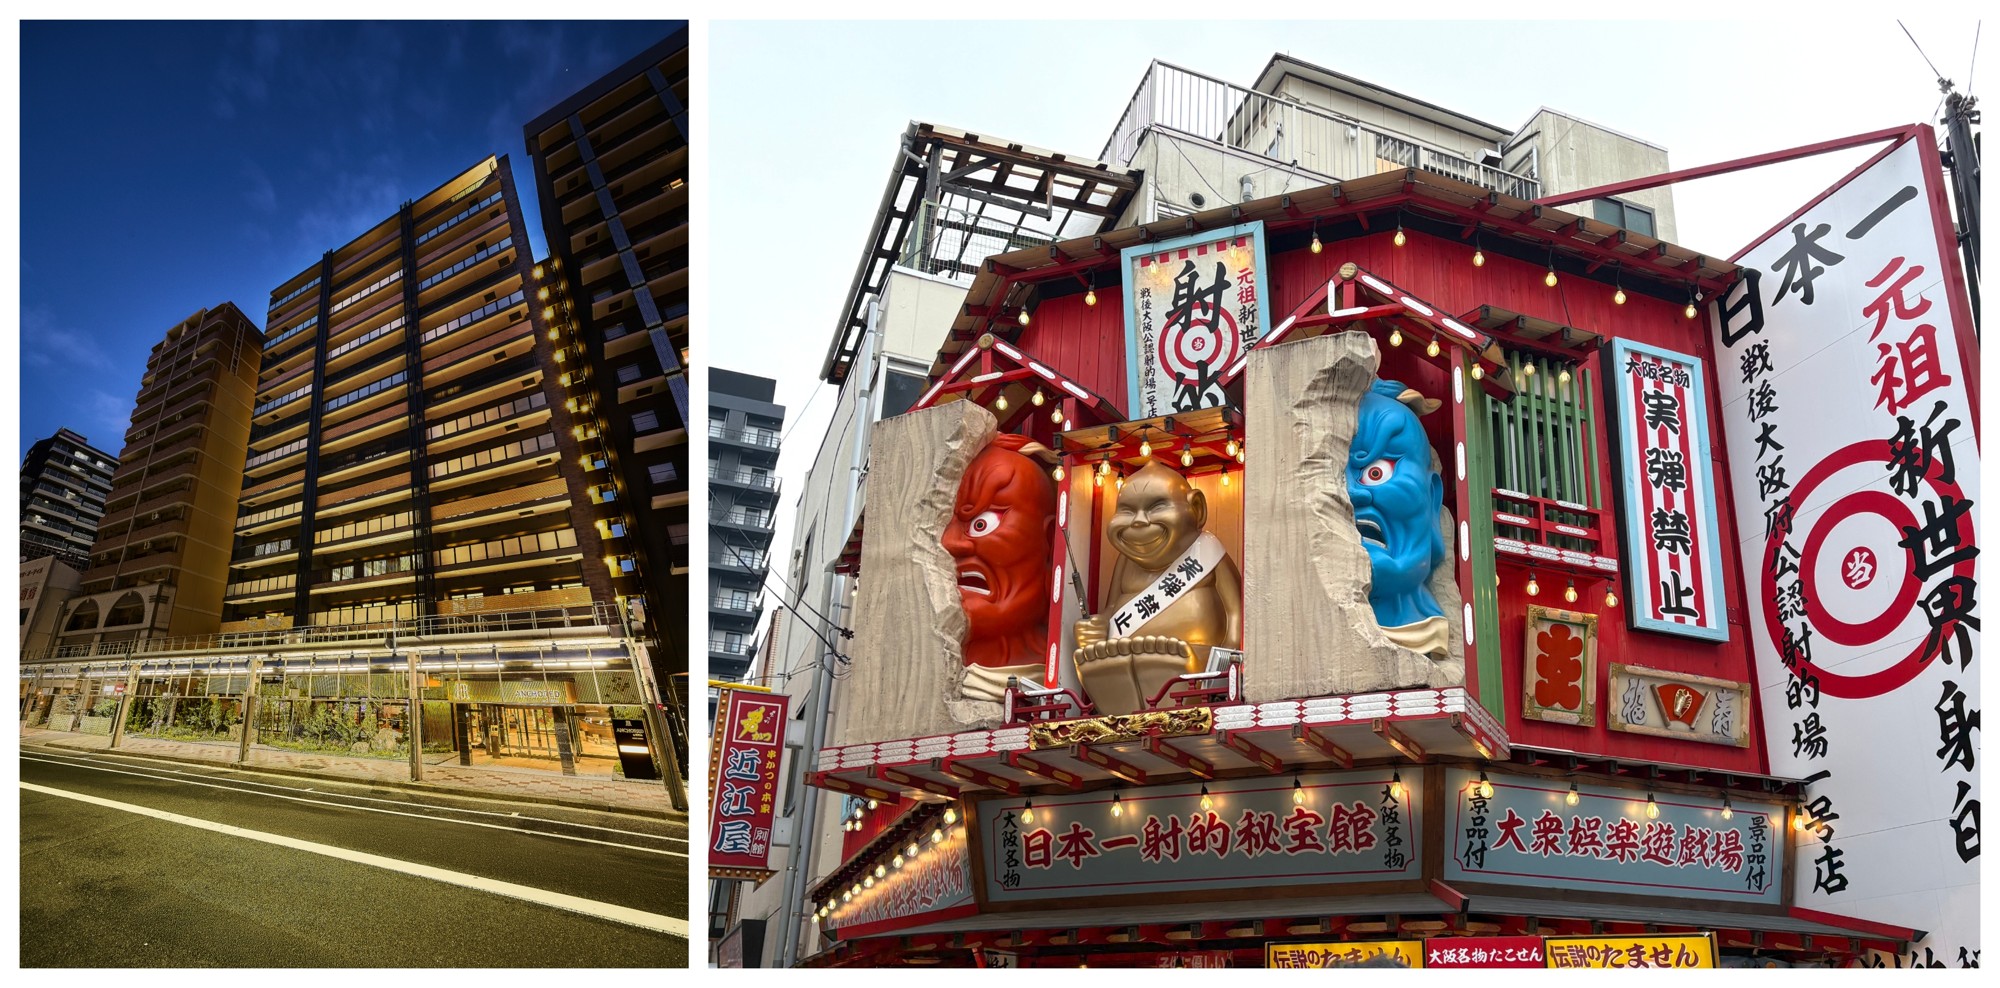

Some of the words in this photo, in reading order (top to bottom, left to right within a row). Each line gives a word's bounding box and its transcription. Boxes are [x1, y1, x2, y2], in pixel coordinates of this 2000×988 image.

[1626, 359, 1690, 388] 大阪名物
[1643, 390, 1700, 620] 実弾禁止
[1114, 556, 1204, 635] 実弾禁止
[1846, 553, 1876, 588] 当
[713, 747, 762, 854] 近江屋
[1022, 801, 1378, 870] 日本一射的秘宝館
[1379, 785, 1405, 869] 大阪名物
[1463, 786, 1492, 869] 景品付
[1002, 811, 1021, 889] 大阪名物
[1490, 807, 1745, 873] 大衆娯楽遊戯場
[1745, 815, 1767, 891] 景品付
[1427, 946, 1543, 964] 大阪名物たこせん
[1549, 943, 1700, 968] 伝説のたません
